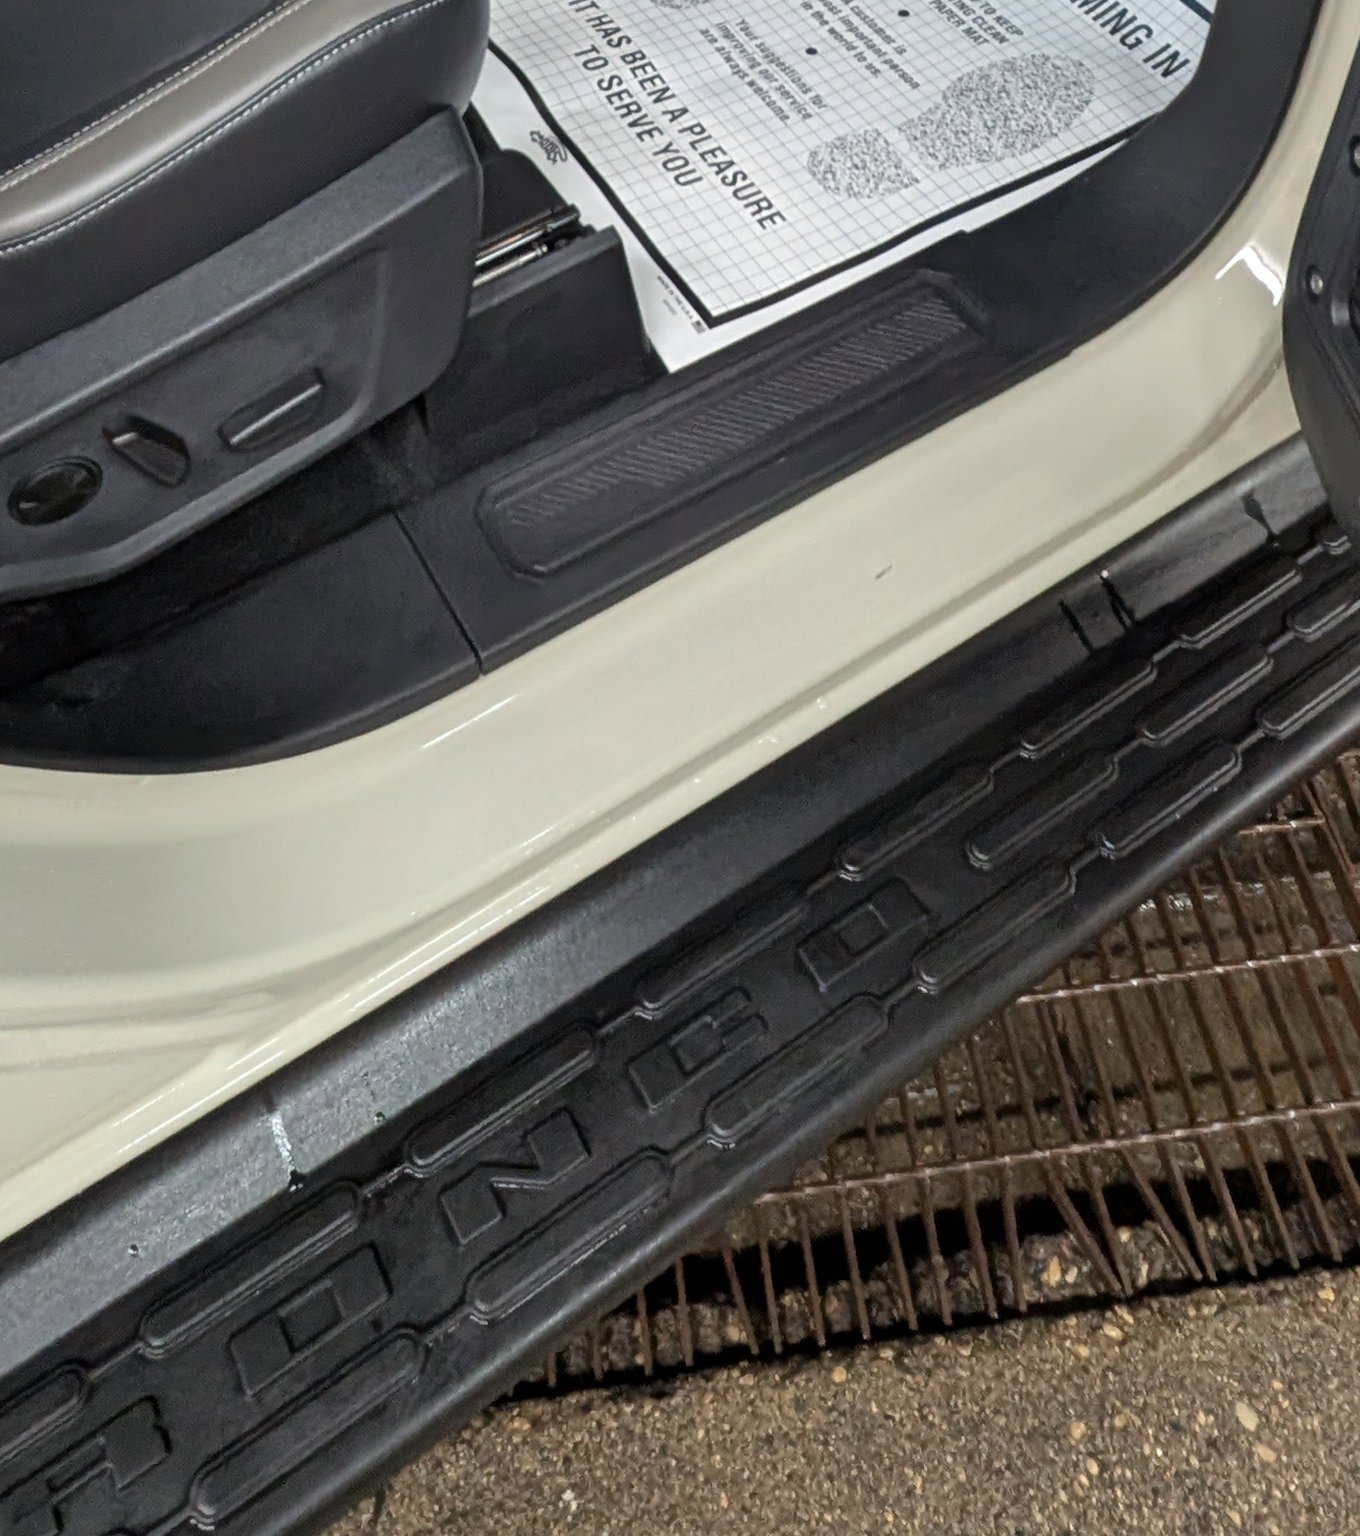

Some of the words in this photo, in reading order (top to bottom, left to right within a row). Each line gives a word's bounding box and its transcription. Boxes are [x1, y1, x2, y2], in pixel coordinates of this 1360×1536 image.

[800, 1, 813, 11] in
[810, 10, 829, 27] the
[827, 26, 859, 52] world
[853, 51, 868, 63] to
[849, 5, 897, 45] customer
[893, 44, 908, 56] is
[962, 26, 990, 46] MAT
[972, 15, 1010, 45] CLEAN
[979, 1, 997, 15] TO
[992, 14, 1025, 37] KEEP
[699, 28, 719, 44] are
[715, 46, 749, 80] always
[736, 18, 759, 41] Your
[754, 42, 813, 95] suggestions
[808, 94, 828, 109] for
[838, 15, 888, 58] important
[880, 58, 920, 90] person
[1142, 43, 1191, 79] IN
[575, 44, 609, 71] TO
[597, 74, 664, 143] SERVE
[653, 141, 704, 187] YOU
[758, 68, 779, 83] our
[775, 84, 813, 120] service
[586, 13, 633, 49] HAS
[620, 49, 677, 105] BEEN
[661, 106, 689, 124] A
[678, 122, 787, 230] PLEASURE
